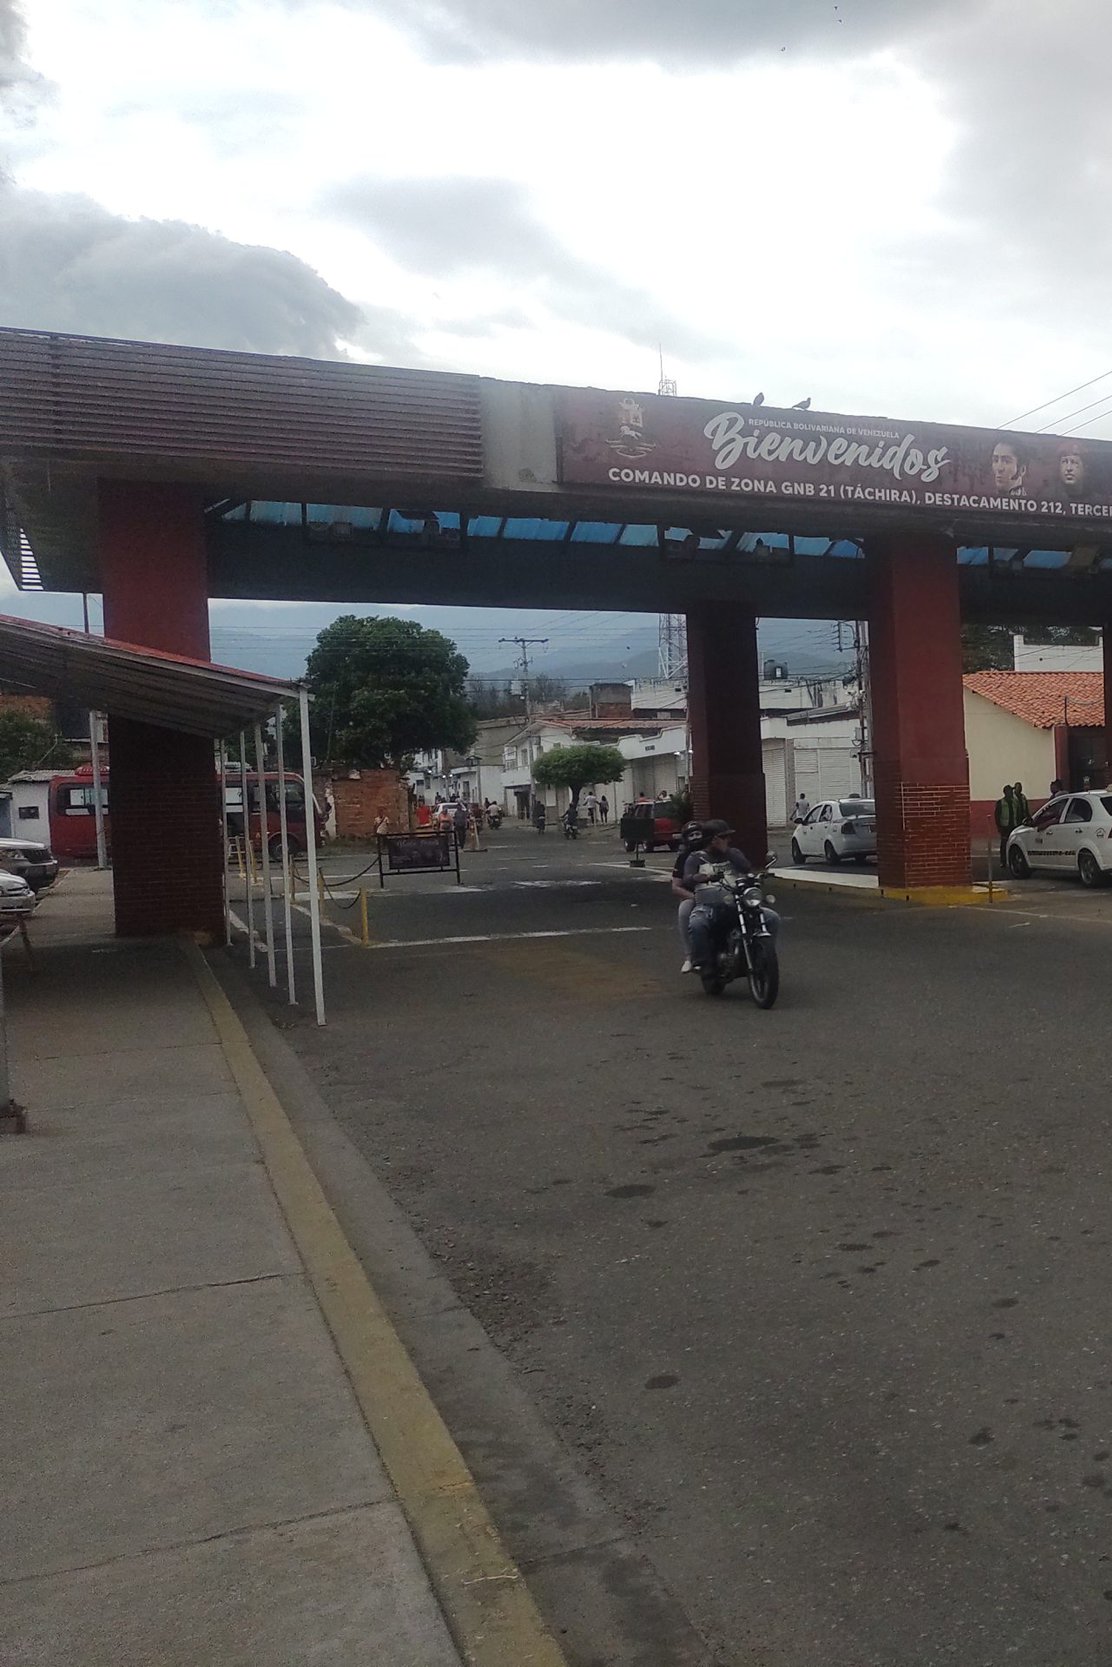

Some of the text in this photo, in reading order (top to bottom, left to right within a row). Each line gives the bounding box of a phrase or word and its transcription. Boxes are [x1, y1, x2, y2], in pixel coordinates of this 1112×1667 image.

[703, 411, 952, 483] Bienvenidos
[748, 418, 900, 439] REPÚBLICA BOLIVARIANA DE VENEZUELA
[608, 467, 701, 488] COMANDO
[706, 475, 726, 490] DE
[731, 477, 777, 494] ZONA
[781, 481, 815, 496] GNB
[819, 484, 835, 497] 21
[840, 484, 921, 505] (TÁCHIRA),
[925, 492, 1037, 512] DESTACAMENTO
[1040, 502, 1066, 516] 212,
